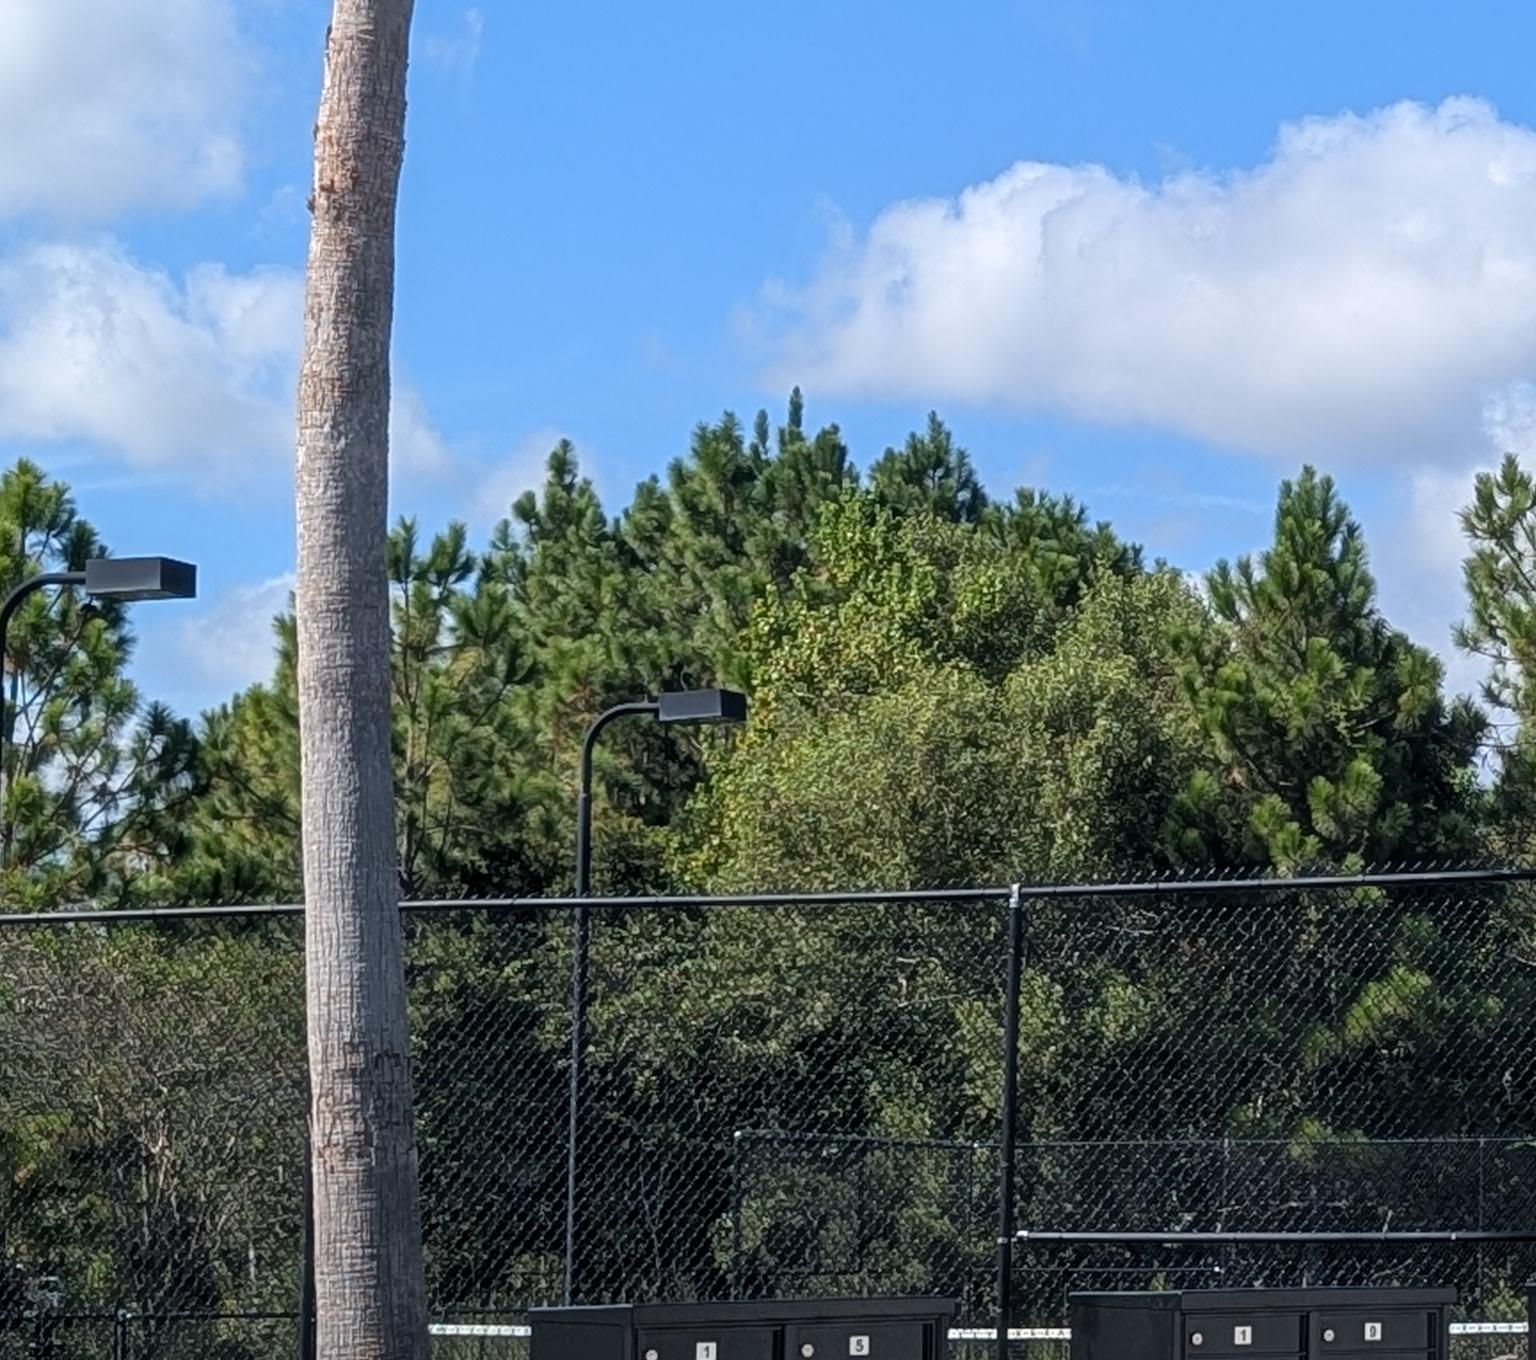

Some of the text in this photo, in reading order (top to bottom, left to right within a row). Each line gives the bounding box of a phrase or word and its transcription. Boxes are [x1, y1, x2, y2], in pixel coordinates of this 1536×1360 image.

[1240, 1329, 1246, 1342] 1
[703, 1345, 710, 1358] 1
[856, 1338, 864, 1353] 5
